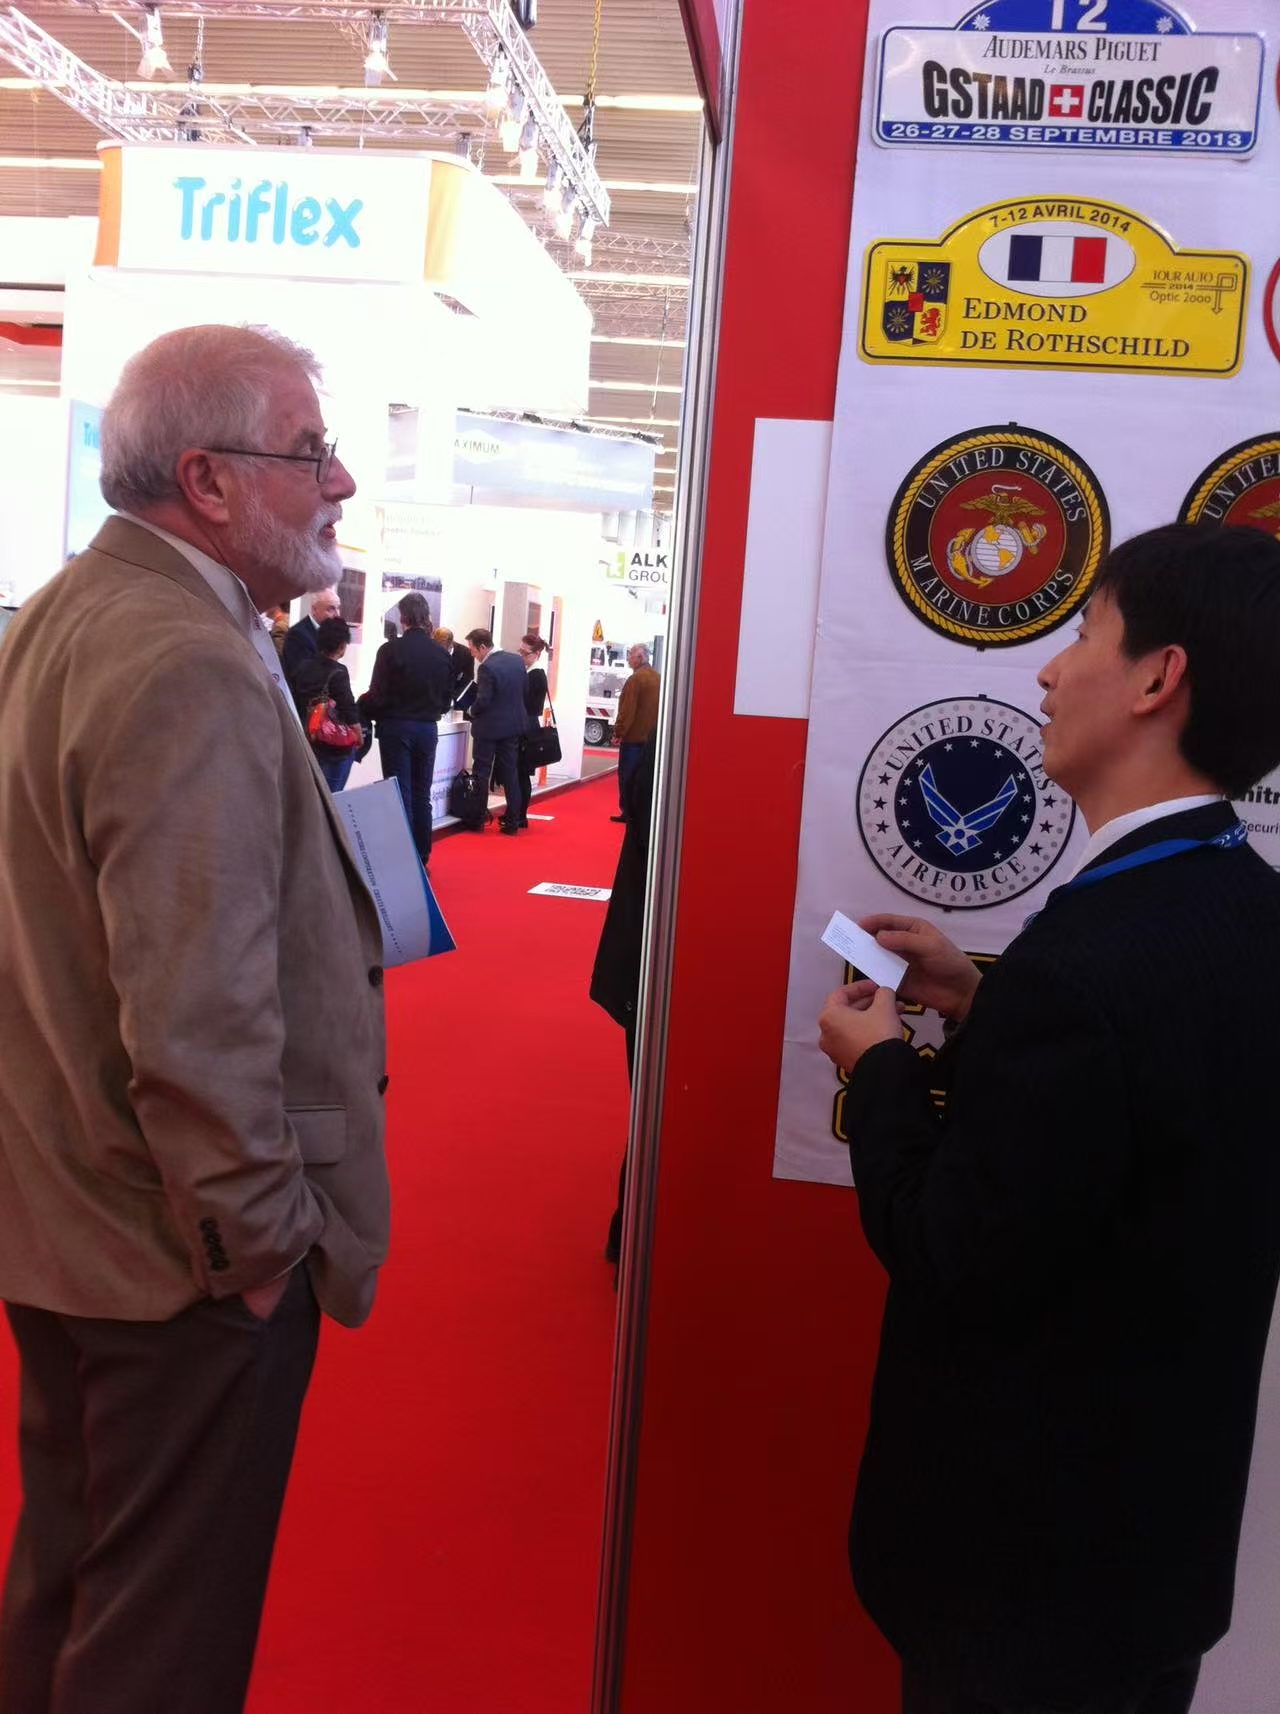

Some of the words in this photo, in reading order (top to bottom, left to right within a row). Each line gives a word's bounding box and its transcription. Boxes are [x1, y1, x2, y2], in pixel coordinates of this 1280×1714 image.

[982, 34, 1088, 60] AUDEMARS
[1094, 36, 1163, 62] PIGUET
[1043, 65, 1059, 75] Le
[1059, 65, 1096, 75] Brassus
[922, 60, 1046, 121] GSTAAD
[1087, 66, 1220, 126] CLASSIC
[890, 123, 1001, 140] 26-27-28
[1008, 127, 1172, 146] SEPTEMBRE
[1180, 131, 1243, 148] 2013
[172, 176, 364, 248] Triflex
[989, 206, 1028, 229] 7-12
[1032, 204, 1085, 220] AVRIL
[1089, 209, 1133, 232] 2014
[962, 297, 1088, 324] EDMOND
[1149, 290, 1180, 304] Optic
[1183, 292, 1212, 304] 2000
[961, 331, 996, 349] DE
[1005, 329, 1190, 358] ROTHSCHILD
[917, 447, 1005, 511] UNITED
[1015, 451, 1087, 522] STATES
[1203, 452, 1280, 518] UNITE
[631, 552, 668, 568] ALK
[911, 555, 989, 627] MARINE
[998, 568, 1074, 626] CORPS
[885, 715, 974, 774] UNITED
